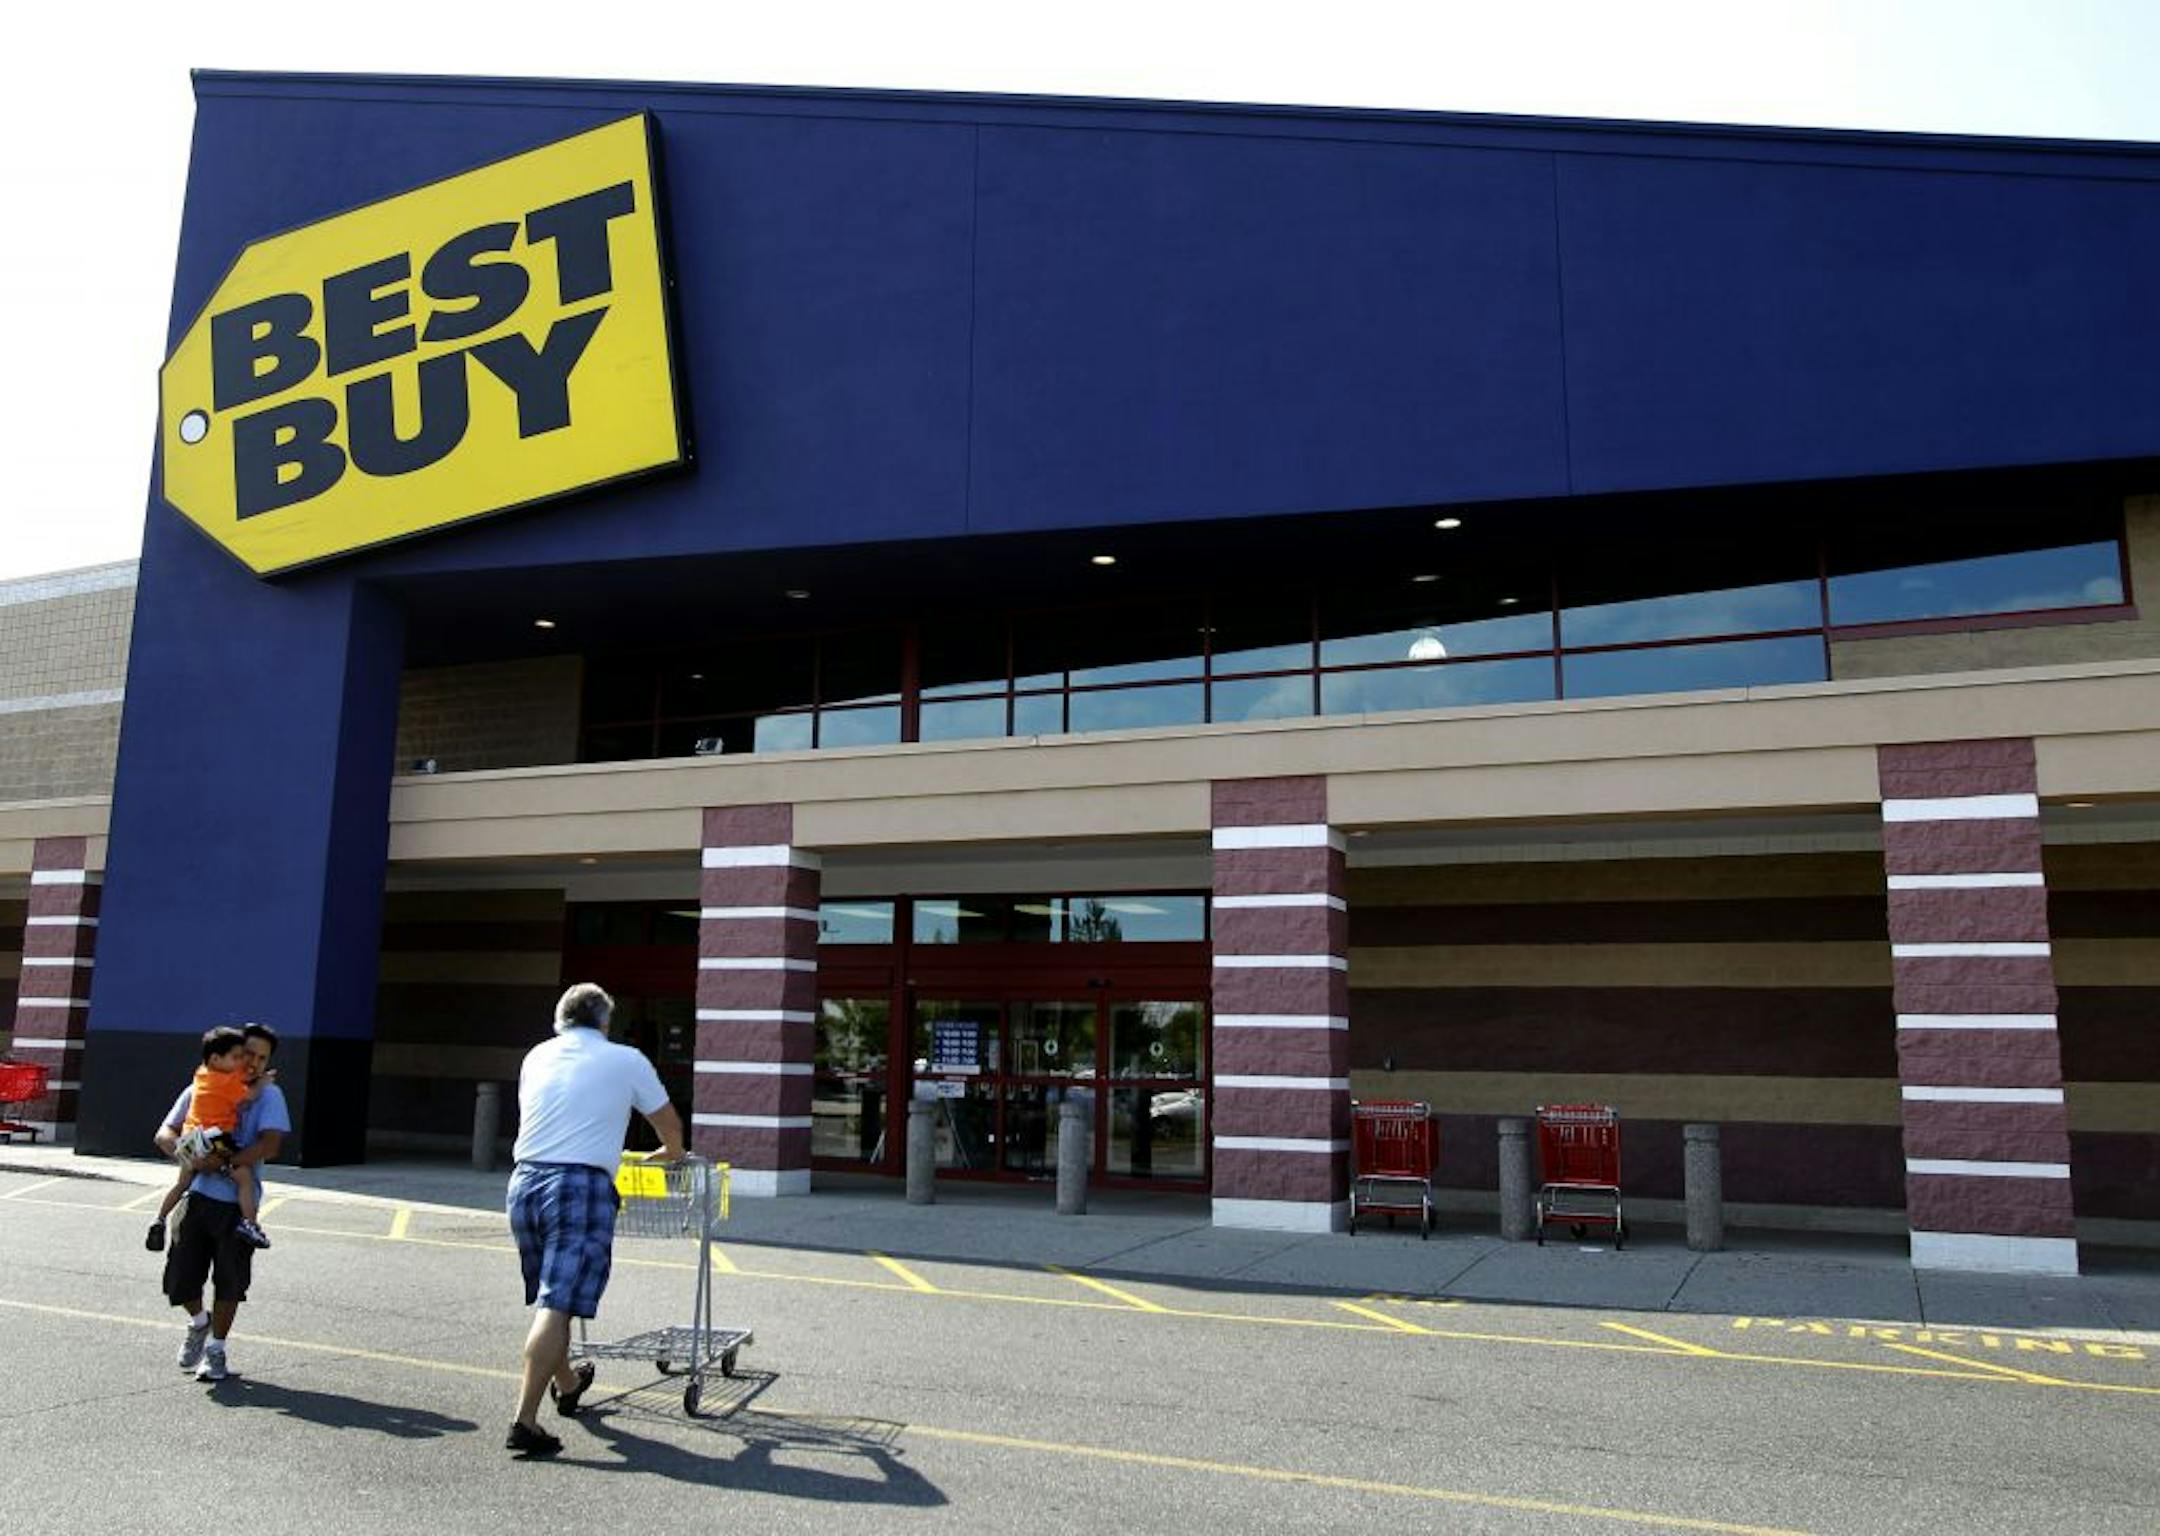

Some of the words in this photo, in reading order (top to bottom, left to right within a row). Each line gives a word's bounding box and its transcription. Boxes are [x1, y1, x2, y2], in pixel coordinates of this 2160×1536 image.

[211, 180, 635, 412] BEST
[232, 305, 612, 521] BUY
[1732, 1317, 2145, 1358] PARKING
